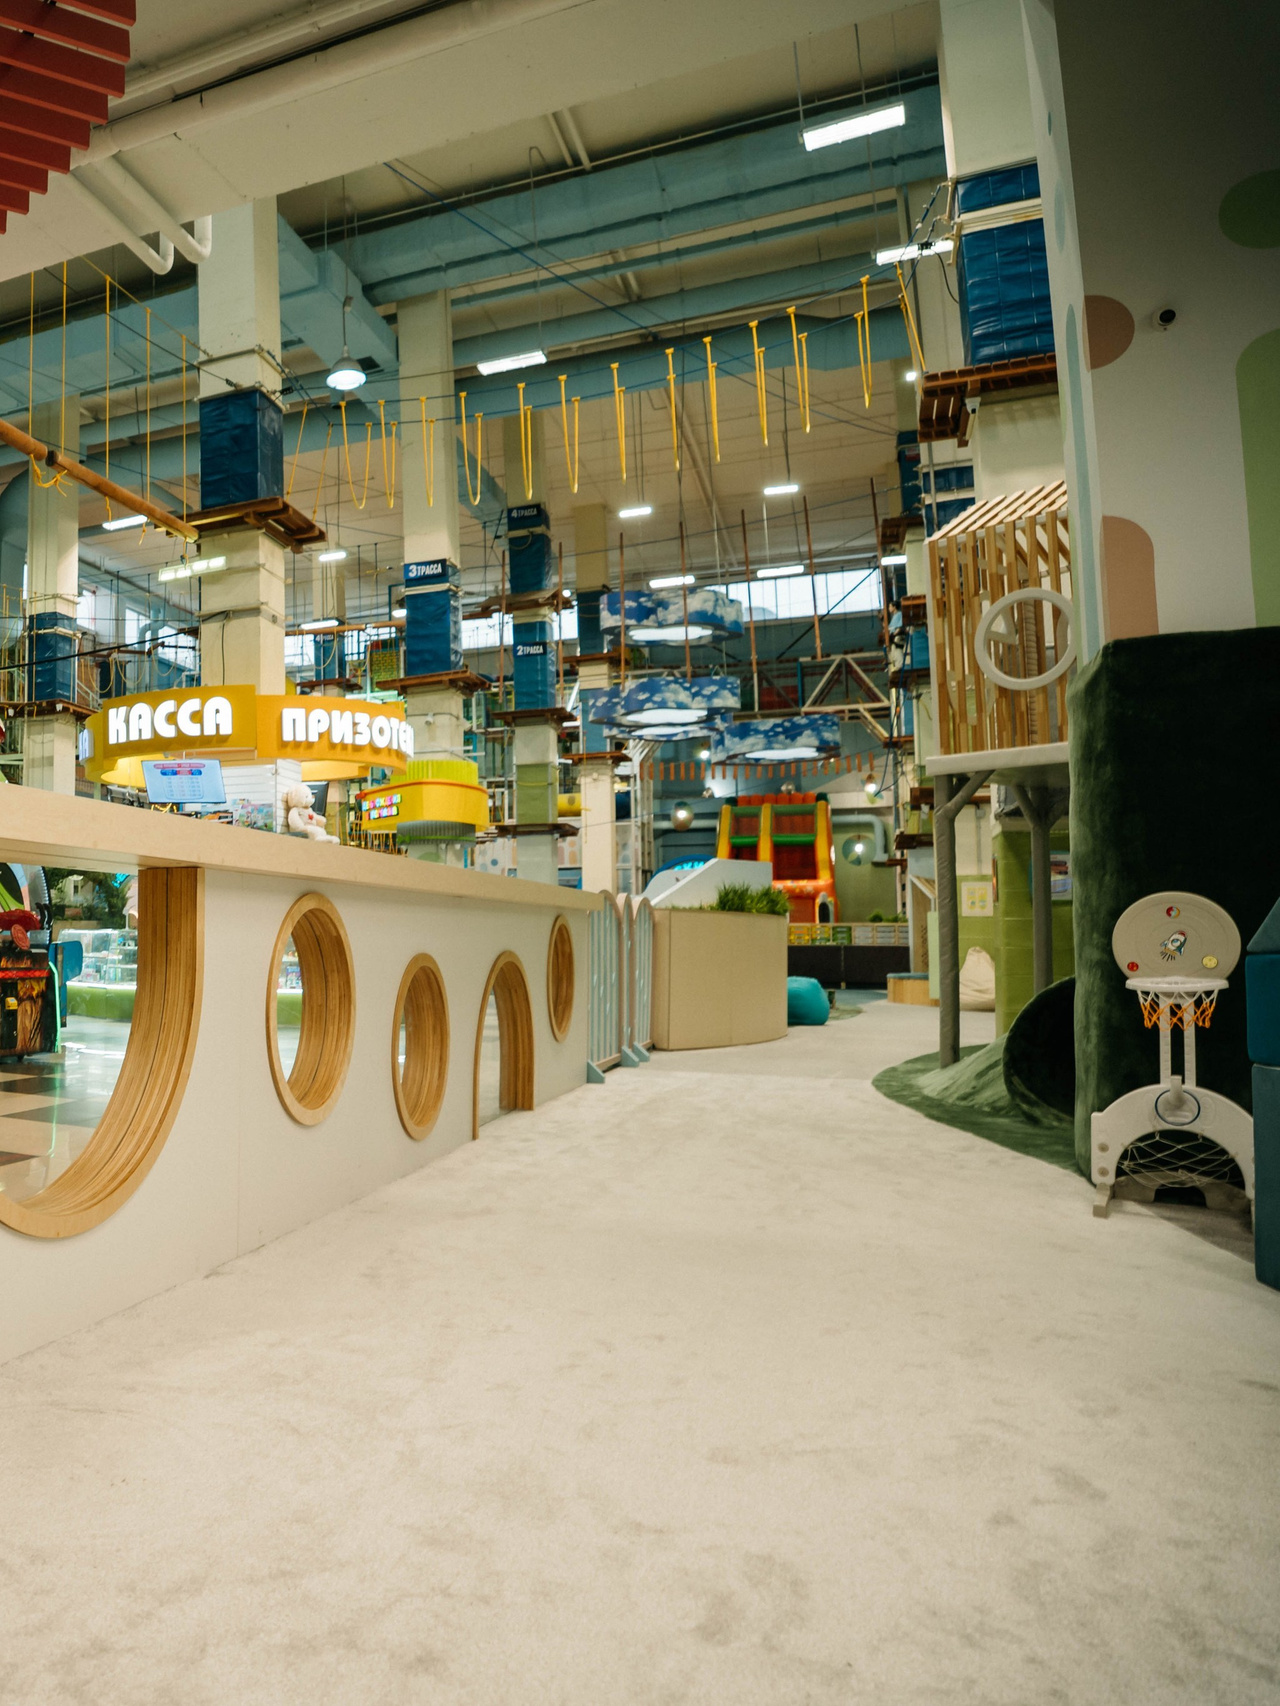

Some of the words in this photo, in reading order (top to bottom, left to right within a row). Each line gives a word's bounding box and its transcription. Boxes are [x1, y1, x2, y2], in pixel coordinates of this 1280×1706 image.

[417, 563, 442, 576] ТРАССА
[523, 644, 544, 655] ТРАССА
[108, 696, 233, 745] КАССА
